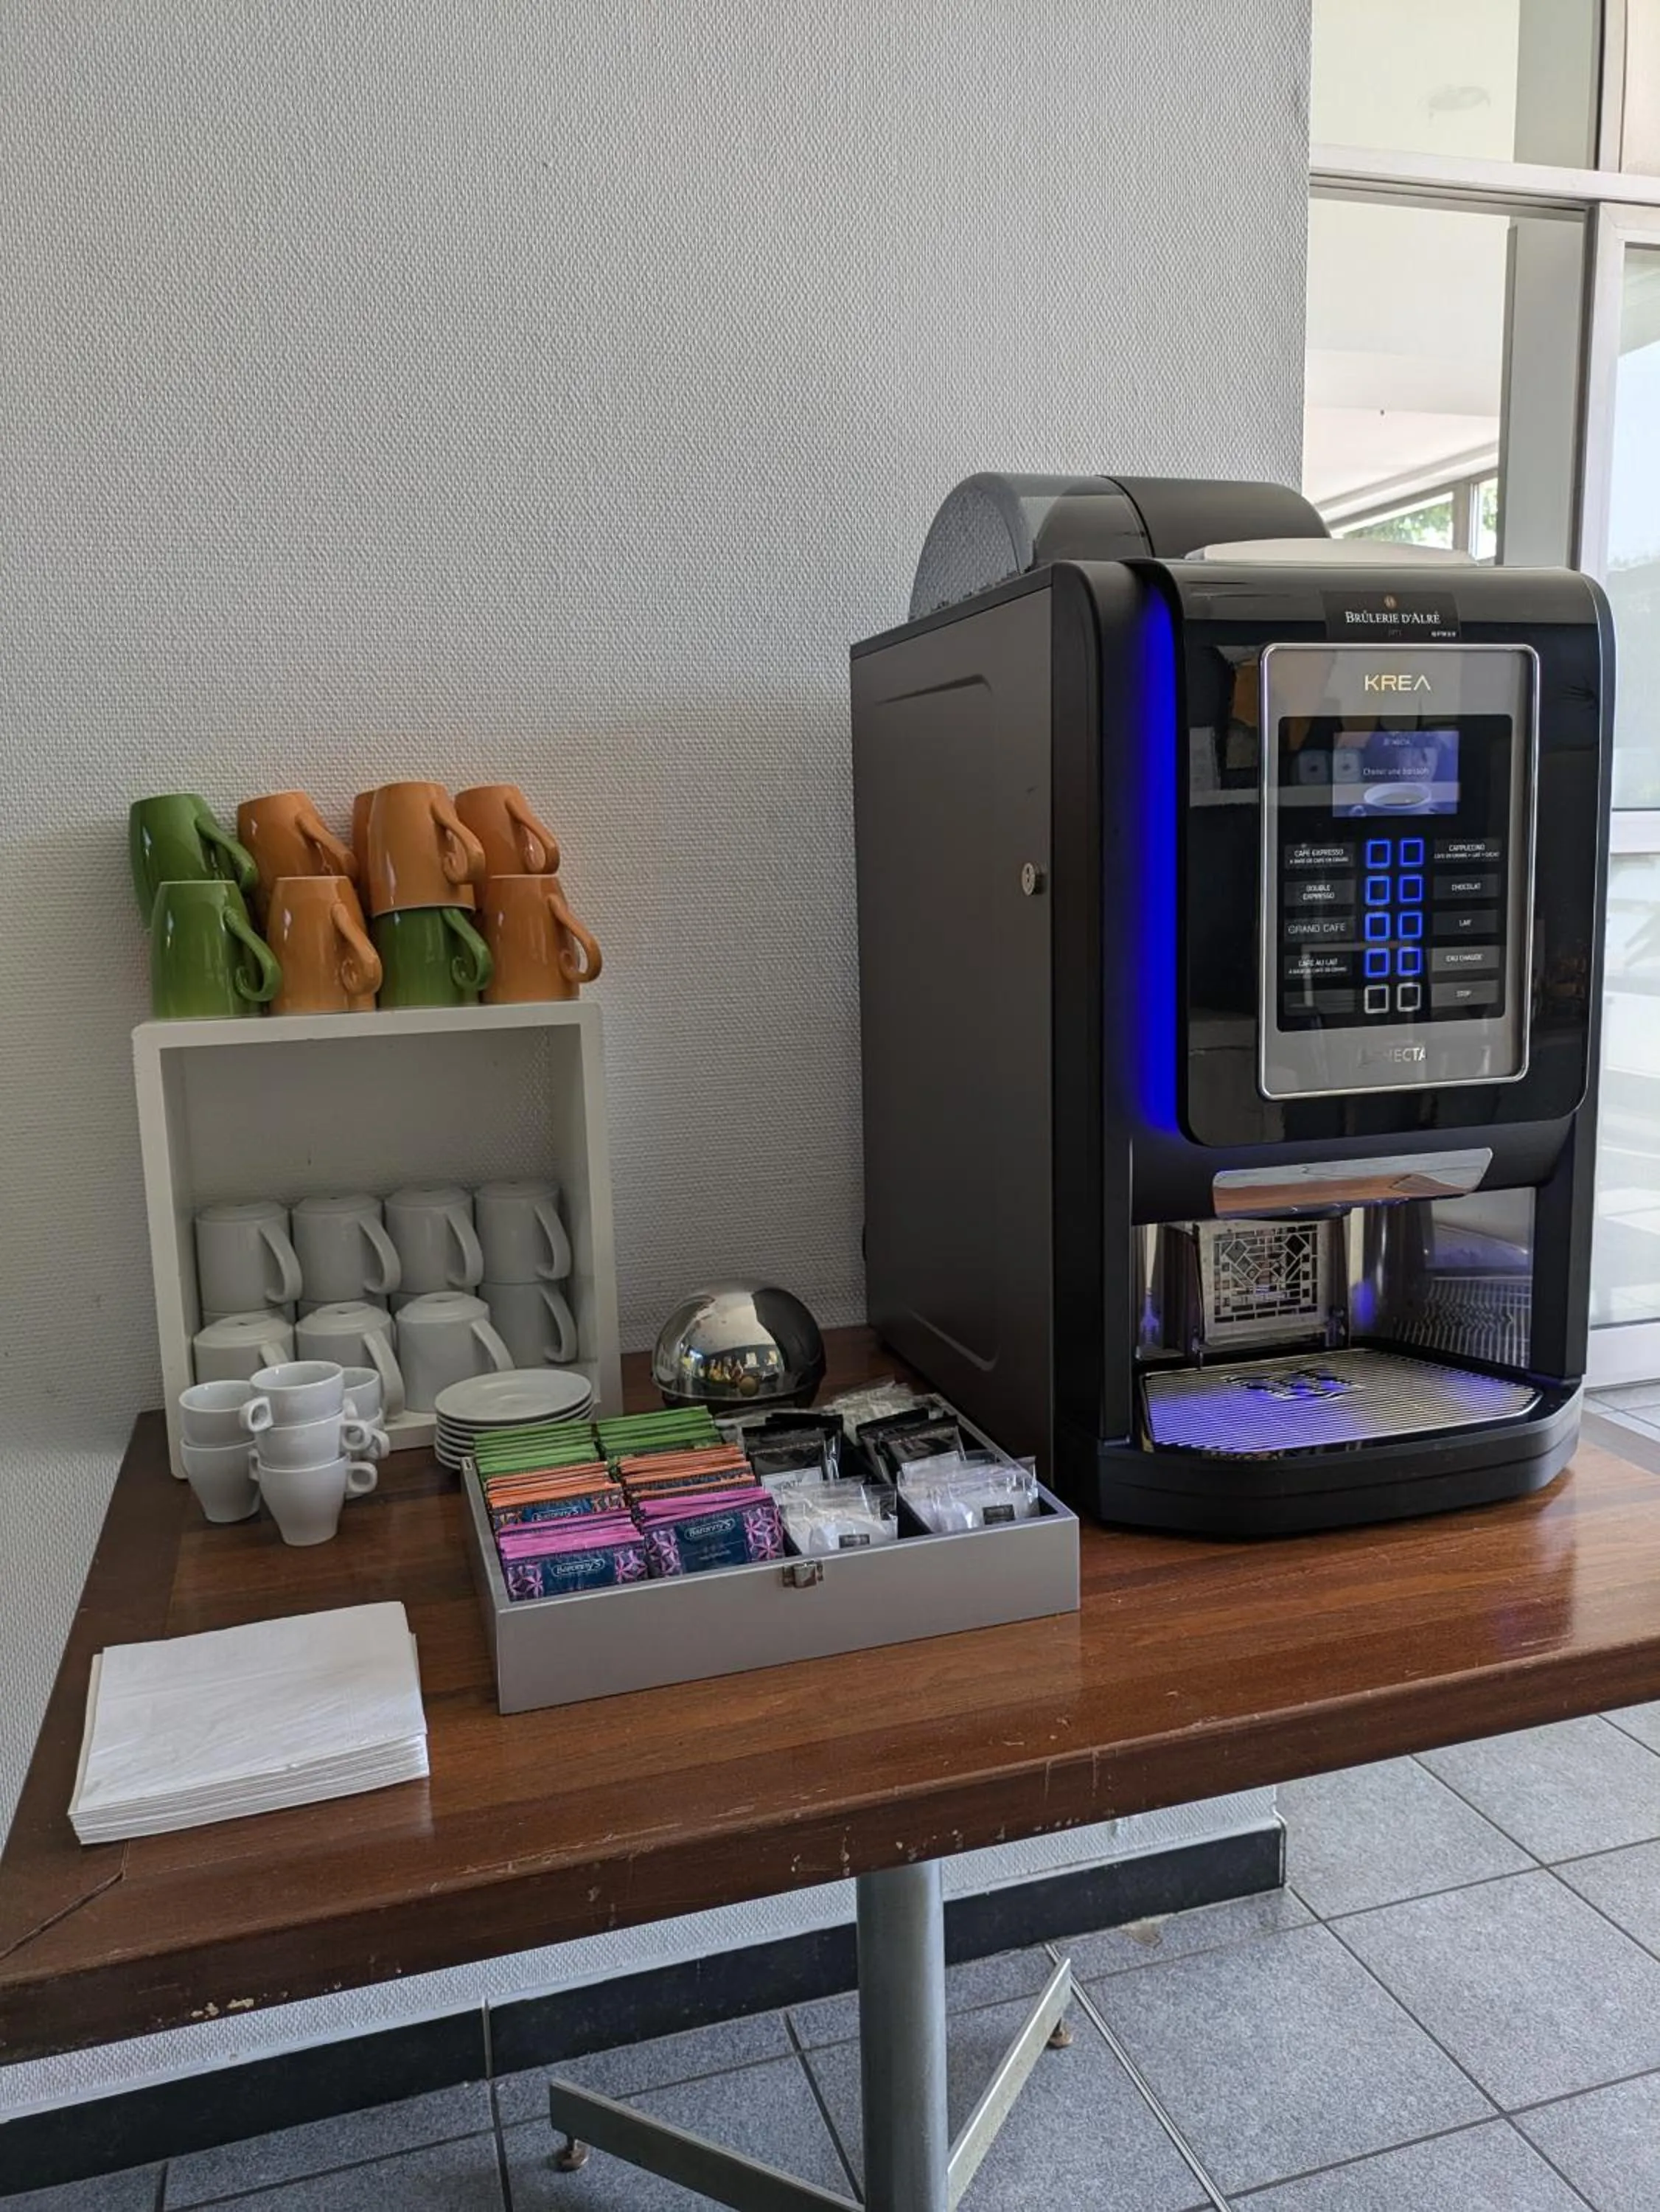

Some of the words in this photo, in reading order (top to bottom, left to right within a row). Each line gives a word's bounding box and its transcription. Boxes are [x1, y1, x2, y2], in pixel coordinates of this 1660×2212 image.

[1345, 610, 1400, 624] BRÛLERIE
[1364, 675, 1431, 691] KREA
[1288, 925, 1320, 934] GRAND
